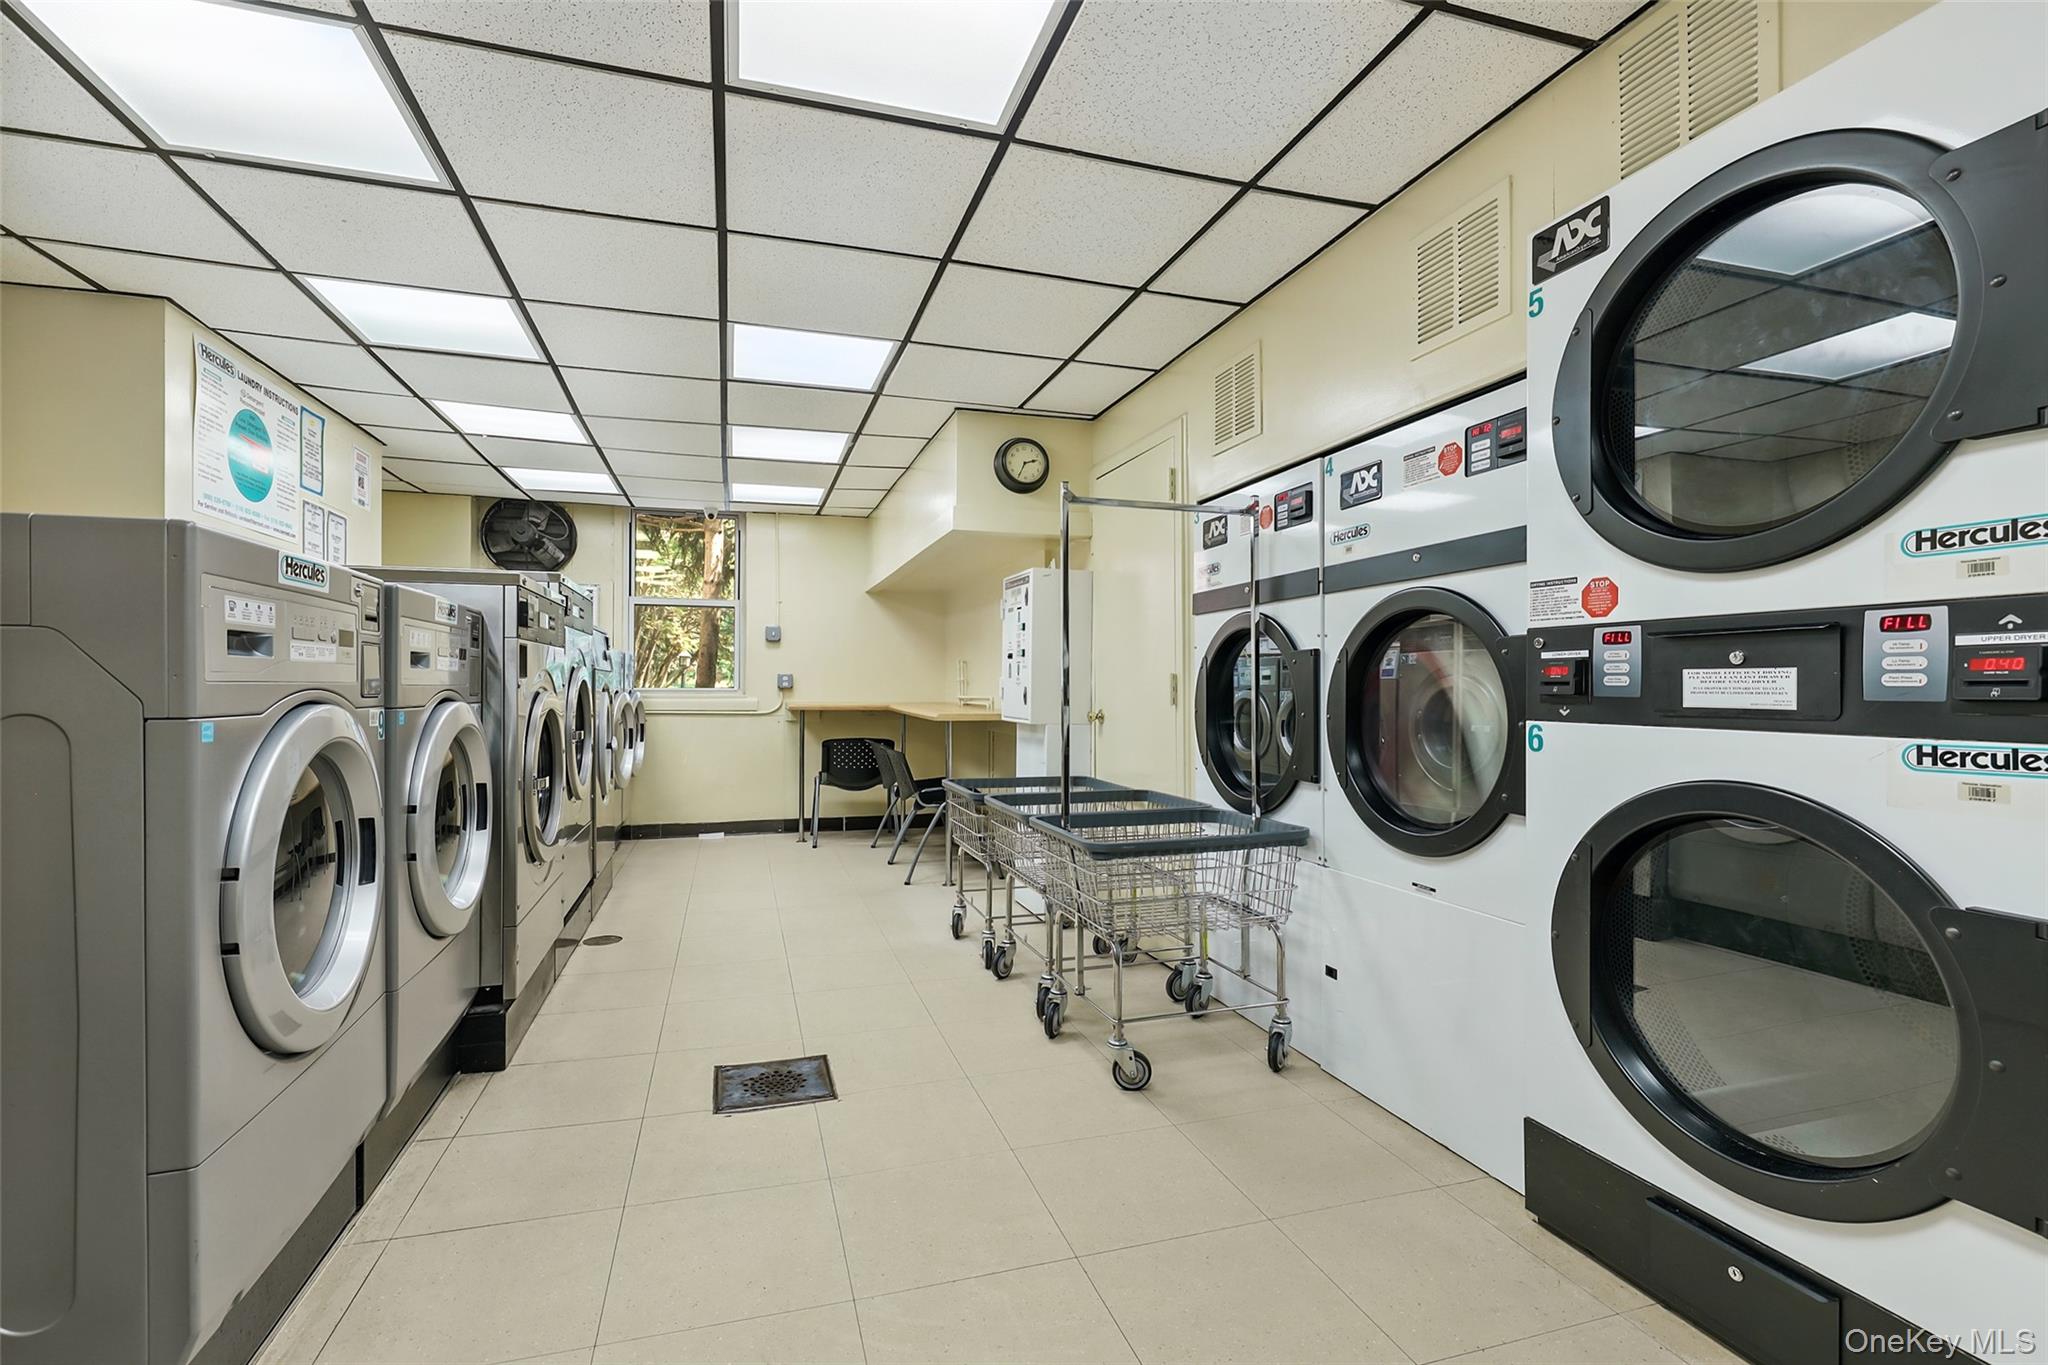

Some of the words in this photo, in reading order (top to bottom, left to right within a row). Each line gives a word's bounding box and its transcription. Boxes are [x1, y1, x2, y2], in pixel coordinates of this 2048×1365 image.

[1551, 204, 1601, 258] ADC
[1529, 287, 1544, 318] 5
[200, 343, 235, 376] Hercules
[237, 370, 262, 393] LAUNDRY
[263, 387, 299, 416] INSTRUCTIONS
[1443, 444, 1457, 454] STOP
[1325, 457, 1334, 477] 4
[1350, 465, 1378, 495] ADC
[1208, 517, 1227, 538] ADC
[1333, 526, 1368, 543] Hercules
[285, 556, 325, 583] Hercules
[1590, 580, 1610, 588] STOP
[1884, 615, 1928, 630] FILL
[1604, 633, 1631, 643] FILL
[2013, 633, 2047, 641] DRYER
[1528, 724, 1544, 752] 6
[1916, 744, 2048, 772] Hercule
